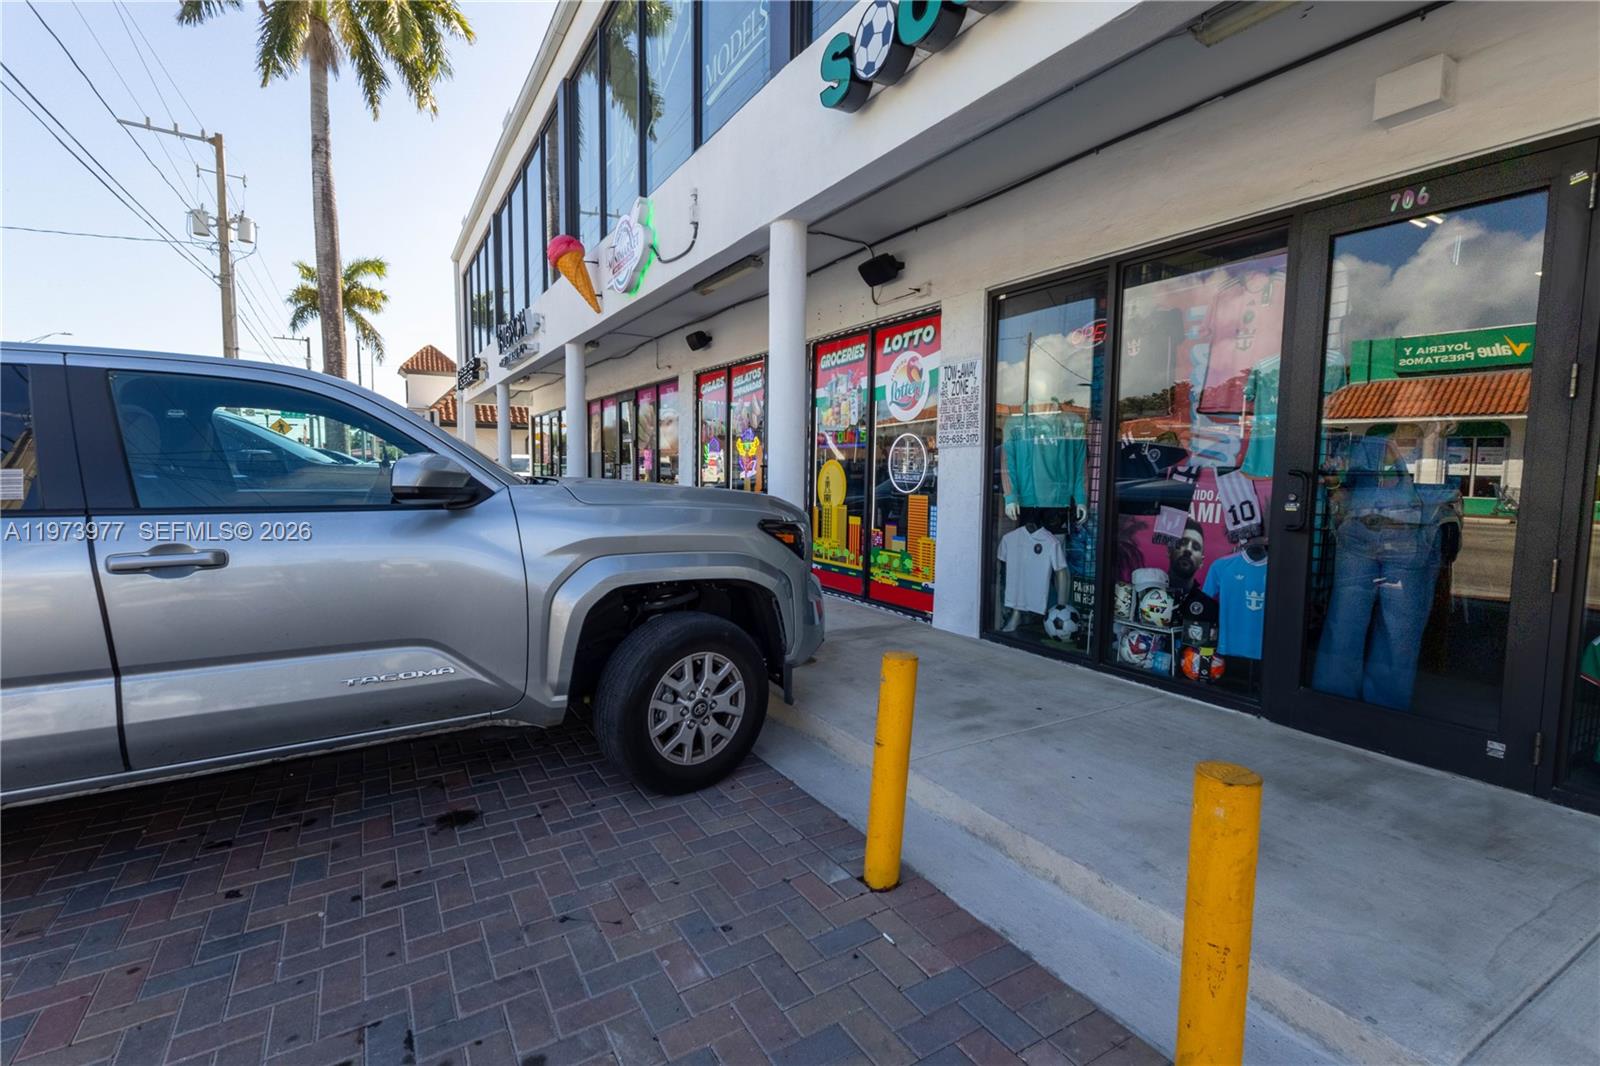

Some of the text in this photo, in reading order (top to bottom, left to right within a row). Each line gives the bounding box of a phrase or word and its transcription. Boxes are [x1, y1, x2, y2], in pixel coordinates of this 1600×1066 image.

[705, 0, 769, 92] MODELS
[1391, 186, 1430, 212] 706
[883, 325, 935, 354] LOTTO
[821, 343, 866, 369] GROCERIES
[701, 377, 725, 394] CIGARS
[951, 379, 969, 397] ZONE
[1228, 500, 1256, 525] 10
[341, 666, 455, 687] TACOMA
